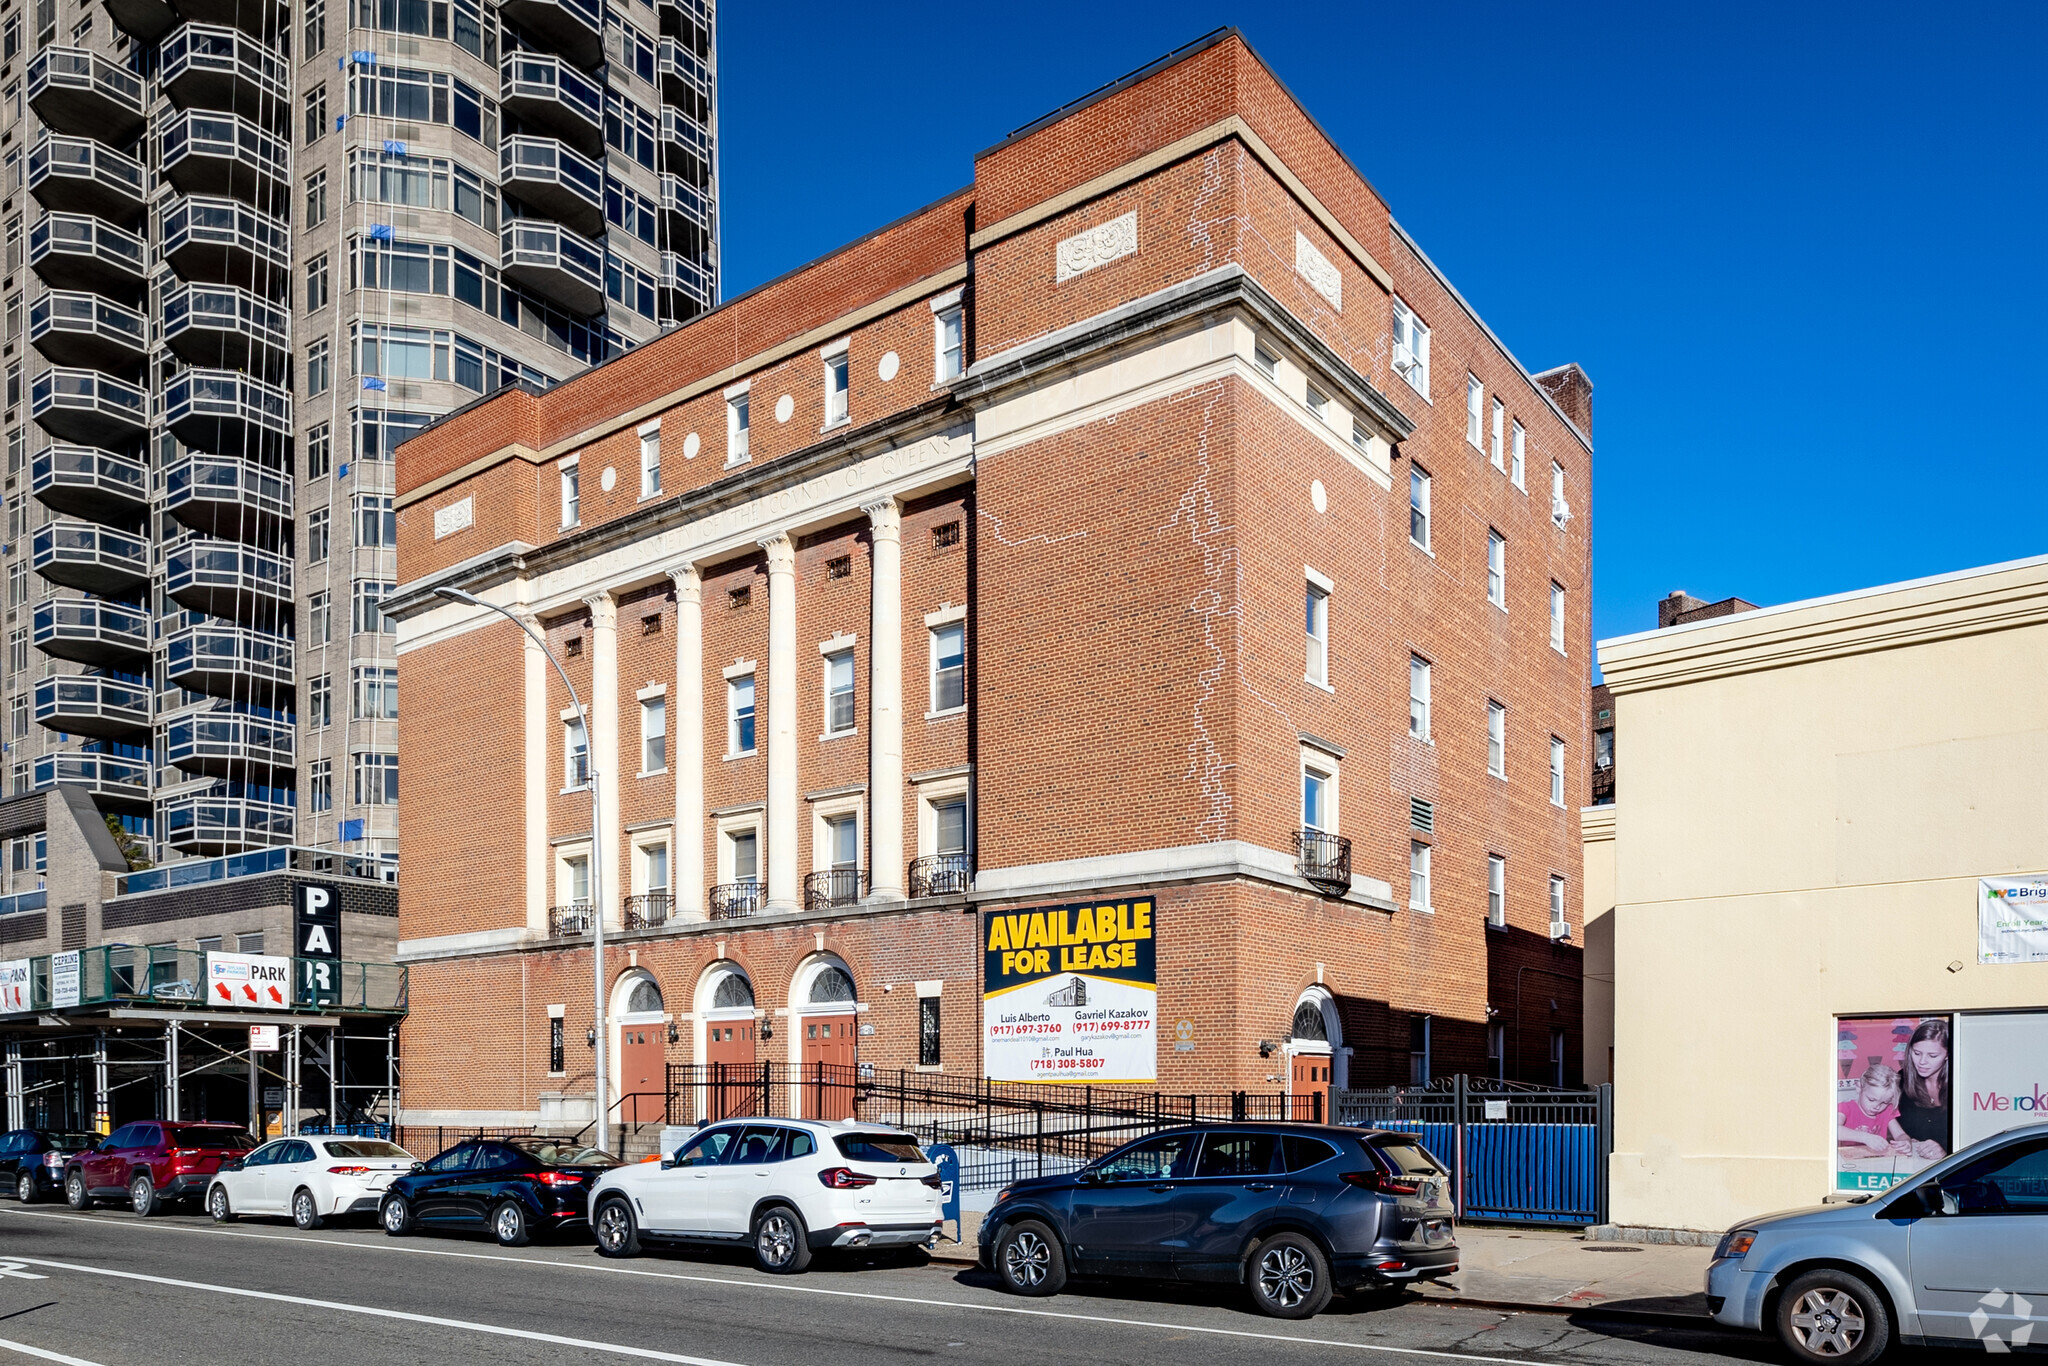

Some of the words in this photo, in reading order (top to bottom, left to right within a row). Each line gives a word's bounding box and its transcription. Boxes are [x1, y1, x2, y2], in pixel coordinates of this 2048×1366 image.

[845, 464, 866, 488] OF
[1988, 888, 2018, 899] NYC
[988, 902, 1151, 951] AVAILABLE
[305, 886, 332, 1005] PAR
[1002, 949, 1051, 975] FOR
[1061, 942, 1137, 971] LEASE
[251, 965, 286, 981] PARK
[1001, 1013, 1016, 1023] Luis
[1018, 1012, 1050, 1022] Alberto
[1075, 1009, 1106, 1020] Gavriel
[1108, 1008, 1148, 1019] Kazakov
[990, 1025, 1014, 1037] (917)
[1016, 1023, 1062, 1034] 697-3760
[1072, 1022, 1099, 1034] (917)
[1101, 1020, 1150, 1031] 699-8777
[1054, 1047, 1074, 1057] Paul
[1076, 1047, 1093, 1057] Hua
[1030, 1059, 1056, 1071] (718)
[1058, 1058, 1105, 1069] 308-5807
